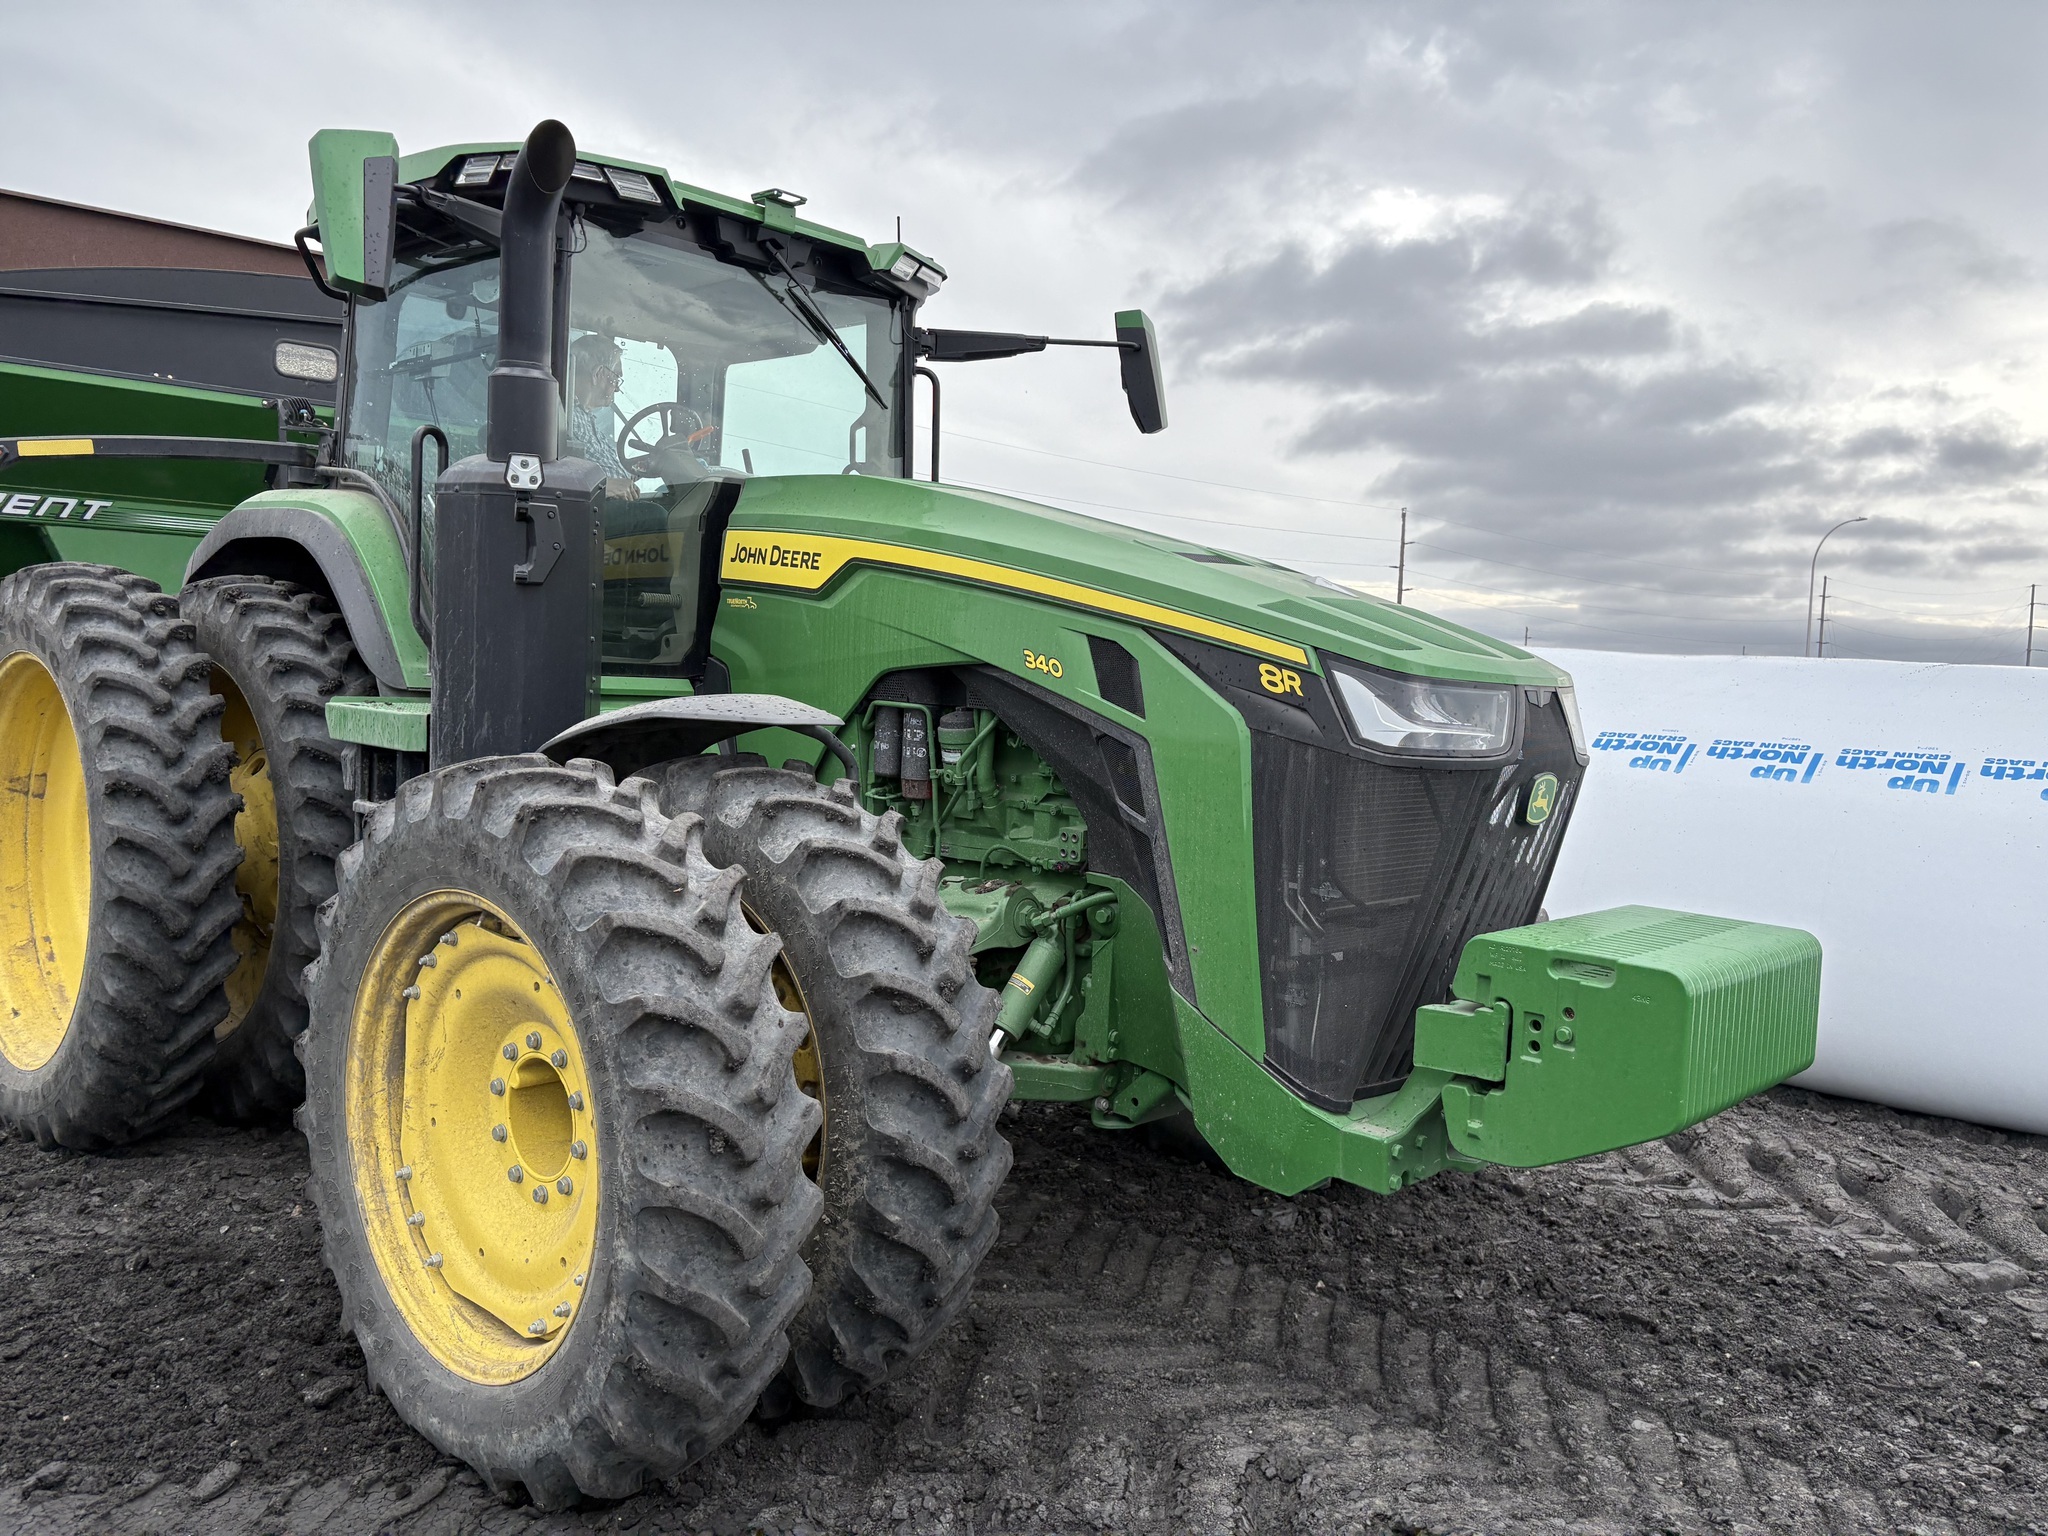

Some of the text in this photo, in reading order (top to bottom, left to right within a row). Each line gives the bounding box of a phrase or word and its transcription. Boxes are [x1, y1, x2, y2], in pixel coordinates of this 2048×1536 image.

[730, 542, 822, 571] JOHN DEERE
[1022, 649, 1064, 678] 340
[1258, 662, 1304, 697] 8R
[1599, 731, 1687, 742] GRAIN BAGS
[1712, 739, 1812, 751] GRAIN BAGS
[1591, 737, 1684, 755] North
[1841, 748, 1952, 761] GRAIN BAGS
[1706, 746, 1809, 765] North
[1984, 757, 2037, 767] BAGS
[1835, 756, 1949, 775] North
[1979, 765, 2048, 781] rth
